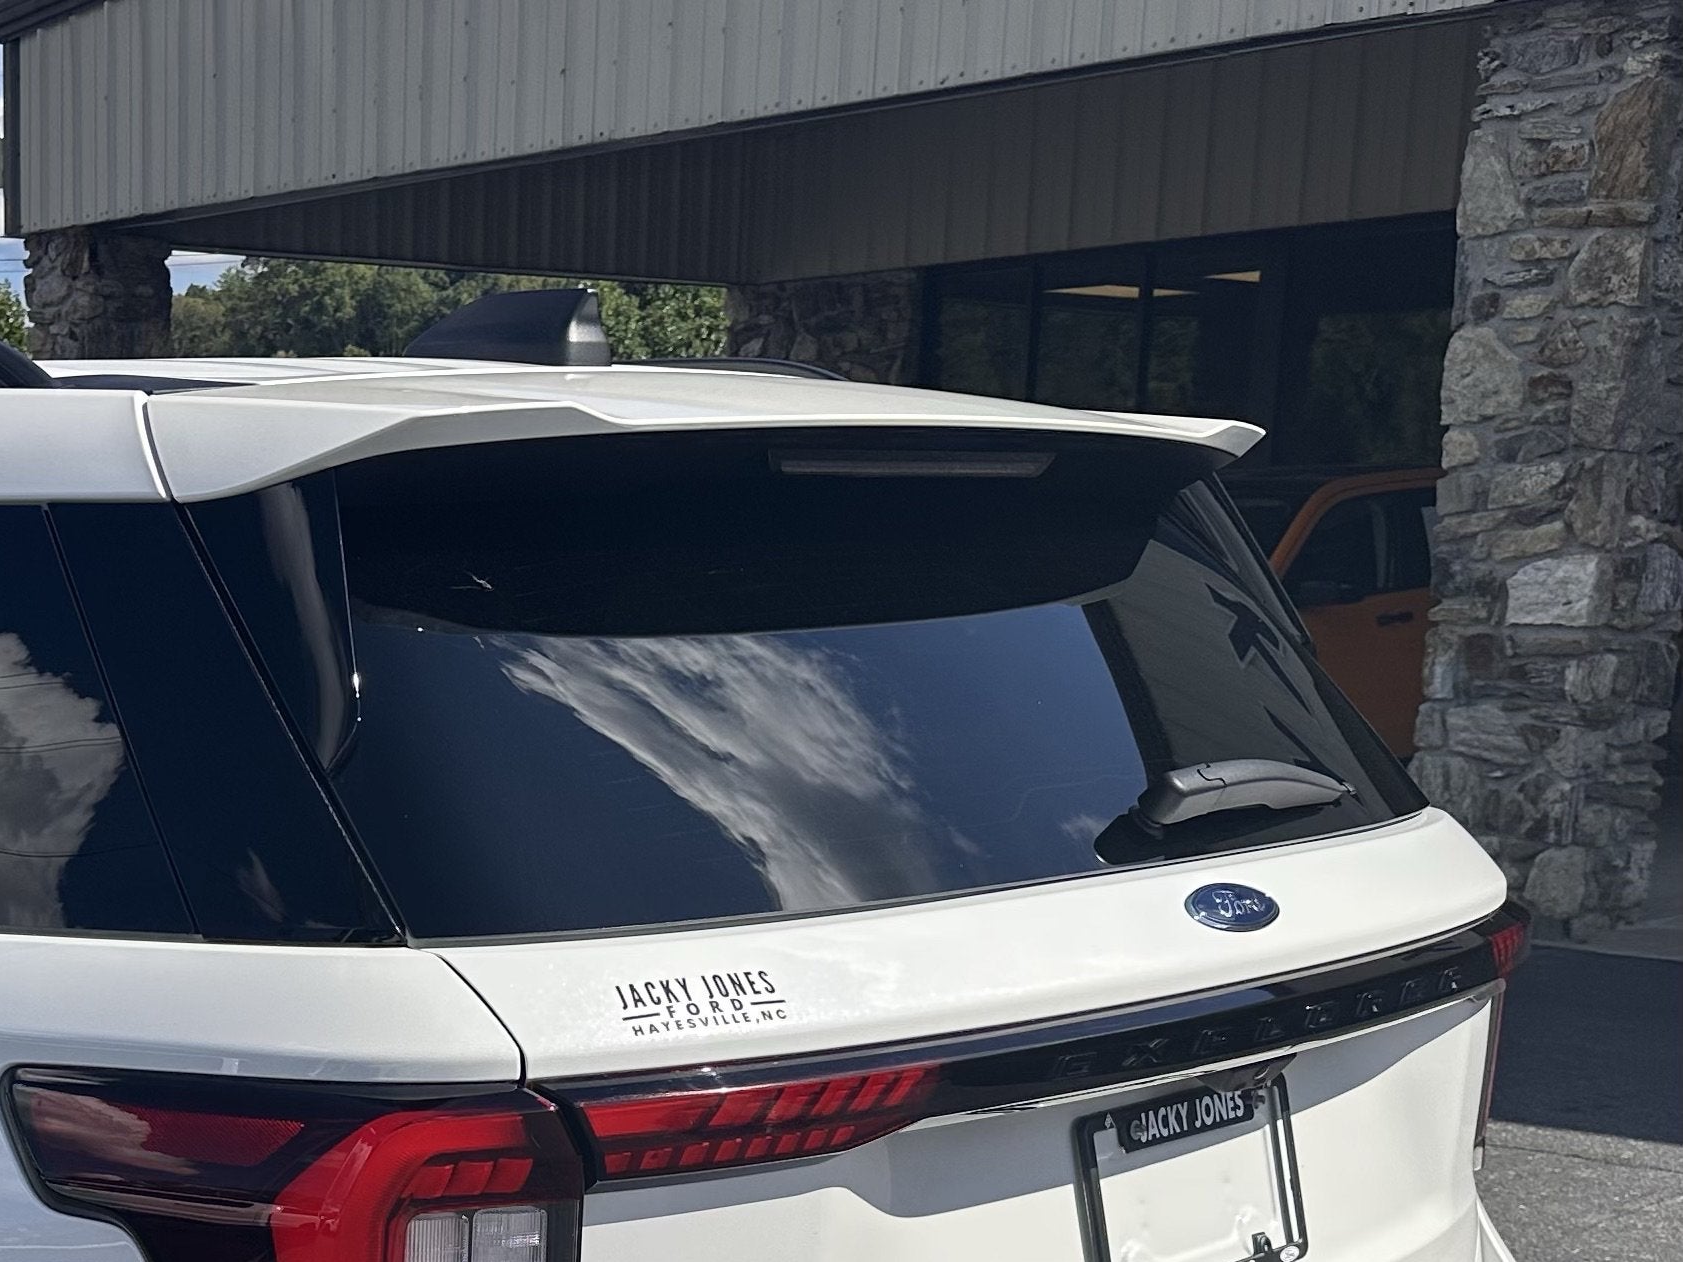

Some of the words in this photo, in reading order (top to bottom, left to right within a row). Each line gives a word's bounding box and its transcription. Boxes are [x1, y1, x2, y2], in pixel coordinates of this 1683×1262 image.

[1211, 889, 1266, 918] Ford
[615, 977, 692, 1010] JACKY
[701, 970, 776, 1000] JONES
[666, 998, 744, 1018] FORD
[1139, 1101, 1189, 1143] JACKY
[1194, 1090, 1245, 1128] JONES
